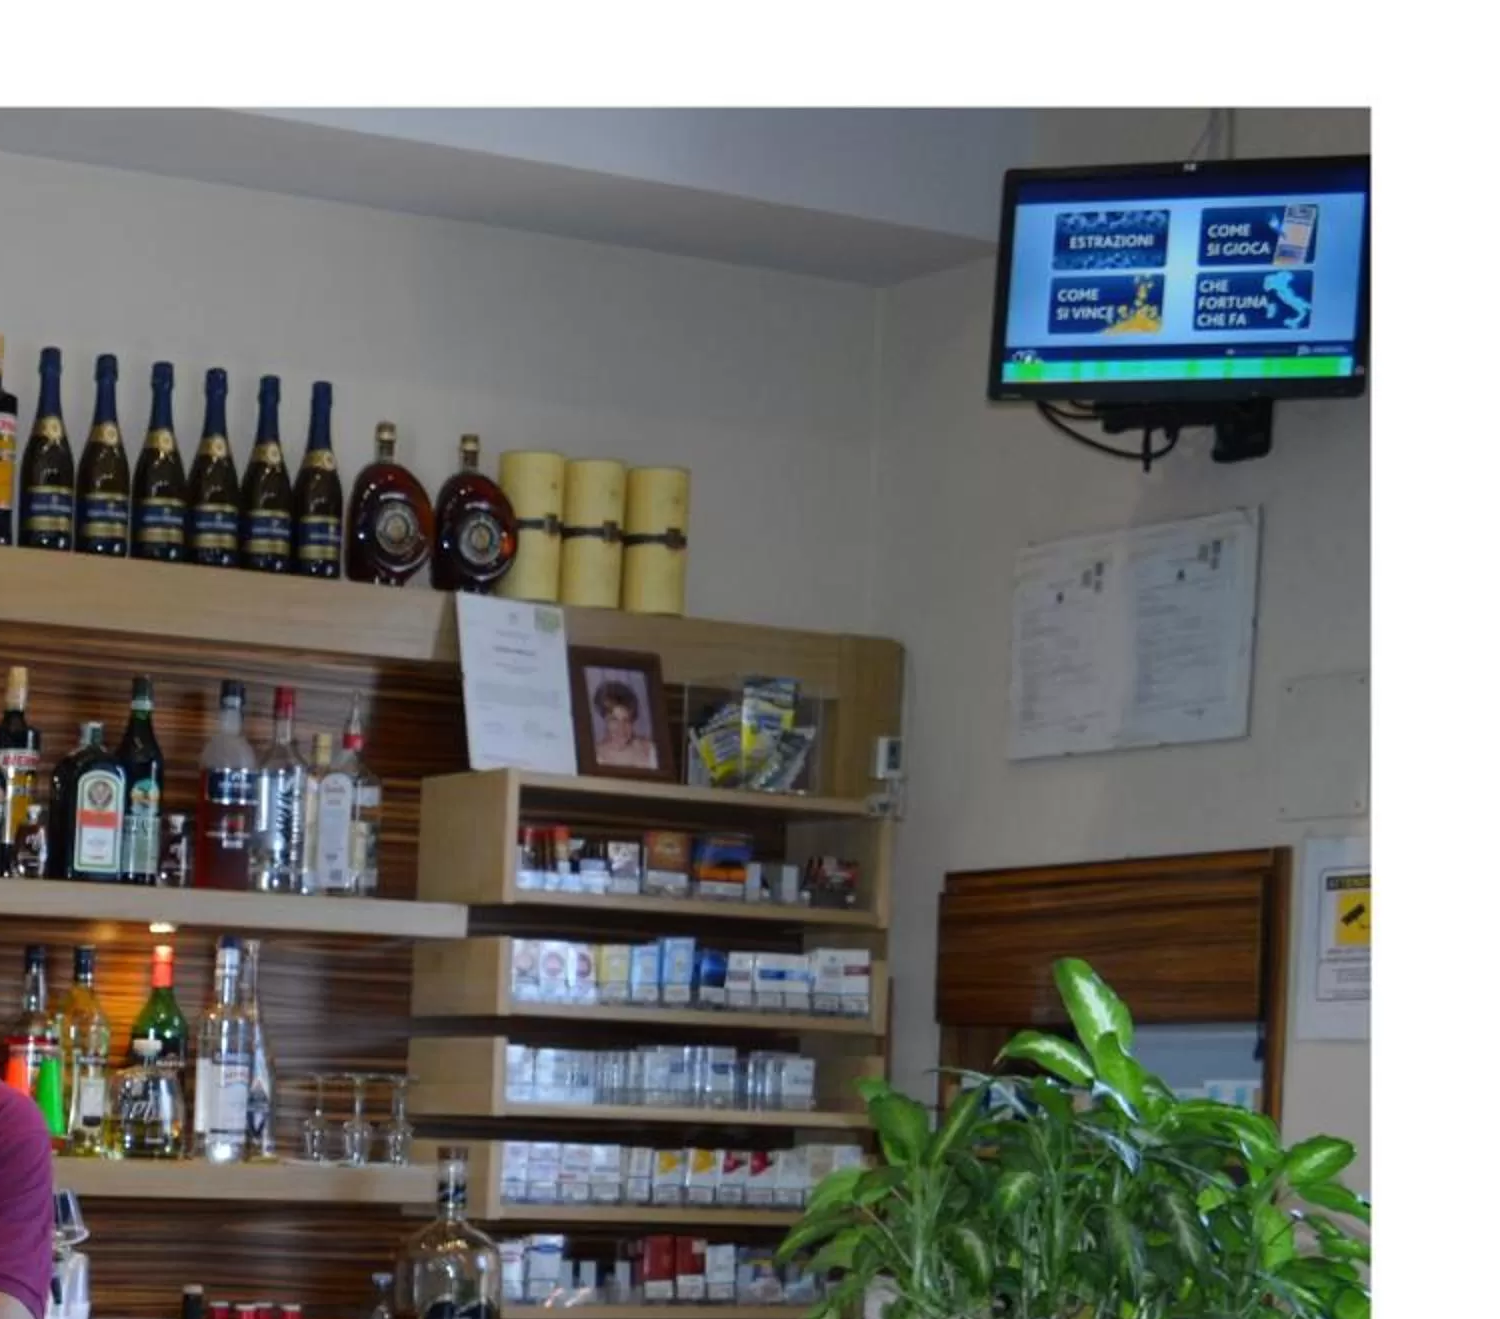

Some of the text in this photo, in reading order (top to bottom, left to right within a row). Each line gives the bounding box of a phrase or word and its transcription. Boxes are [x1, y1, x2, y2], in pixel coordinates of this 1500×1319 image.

[1207, 223, 1252, 238] COME
[1069, 234, 1155, 249] ESTRAZIONI
[1206, 242, 1271, 256] SI GIOCA
[1199, 279, 1229, 293] CHE
[1057, 288, 1099, 302] COME
[1198, 295, 1268, 311] FORTUNA
[1056, 305, 1114, 320] SI VINCE
[1196, 313, 1247, 327] CHE FA
